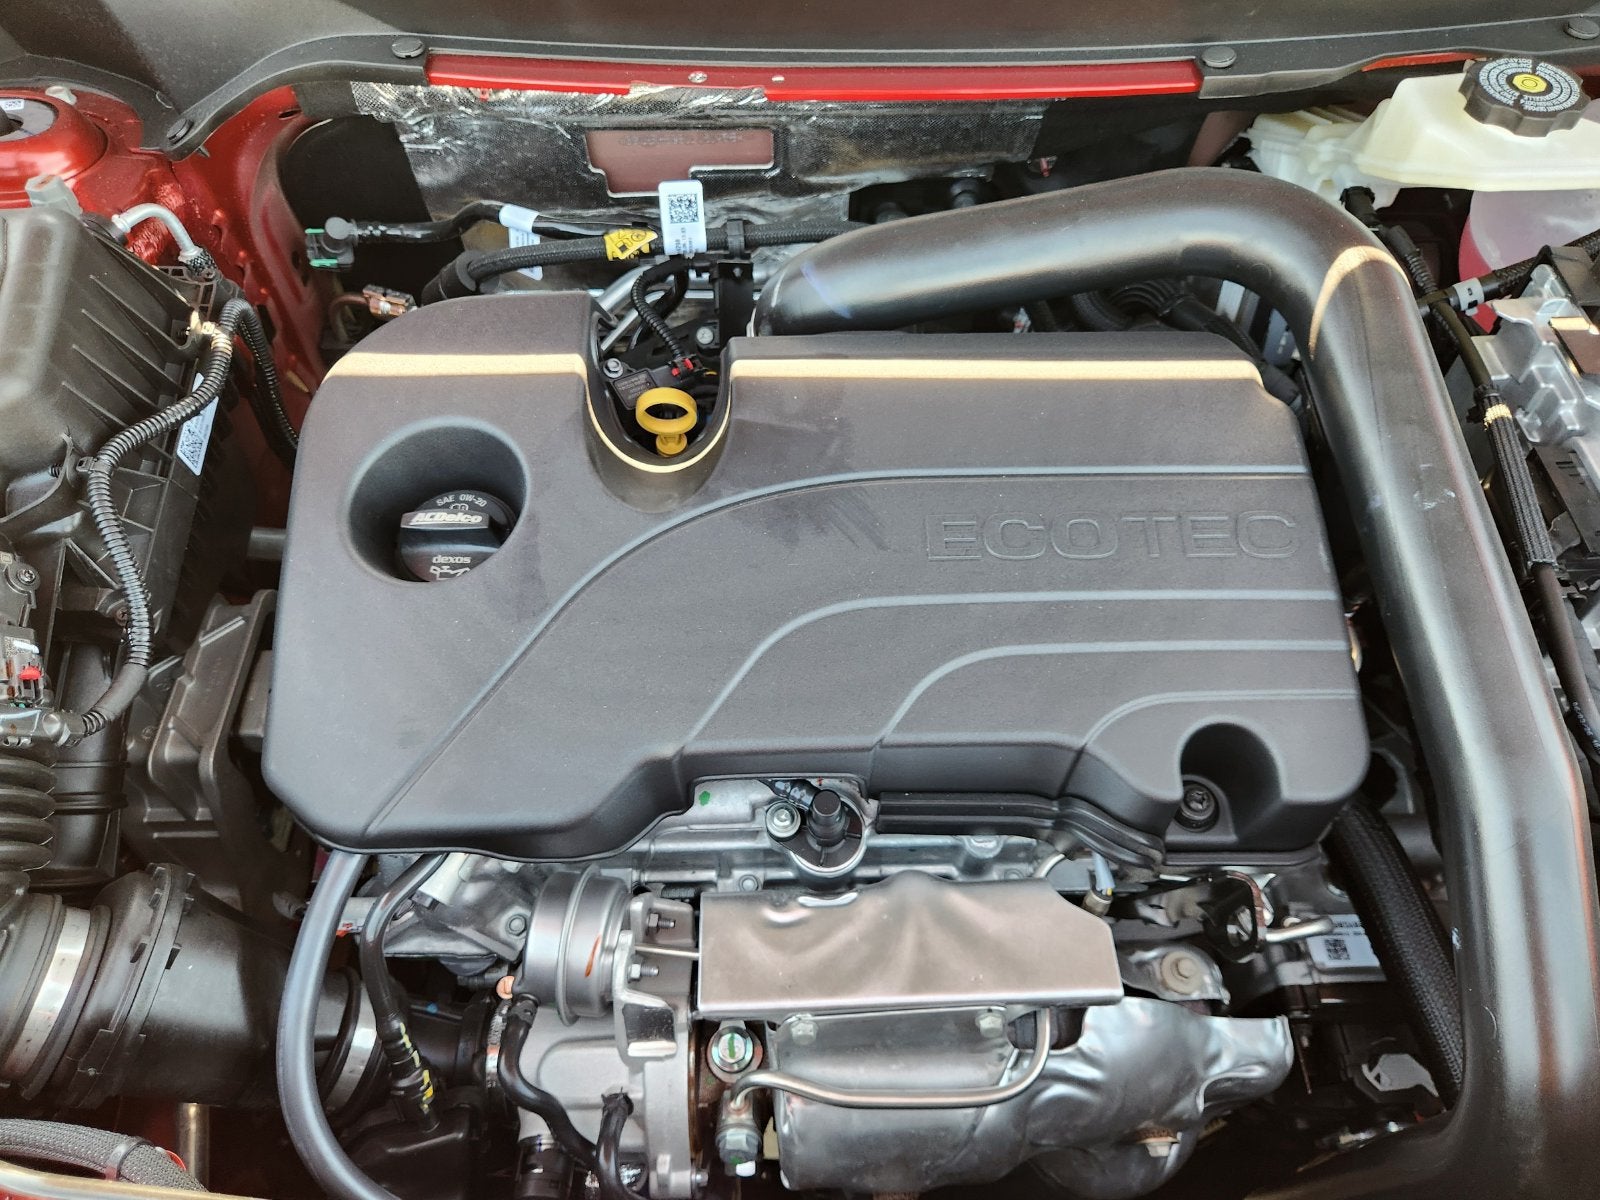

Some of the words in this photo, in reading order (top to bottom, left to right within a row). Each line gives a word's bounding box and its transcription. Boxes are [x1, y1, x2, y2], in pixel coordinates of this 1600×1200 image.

[436, 494, 455, 506] SAE
[459, 494, 487, 507] 0W-20
[409, 512, 483, 525] ACDelco
[926, 510, 1297, 561] ECOTEC
[432, 555, 471, 564] dexos
